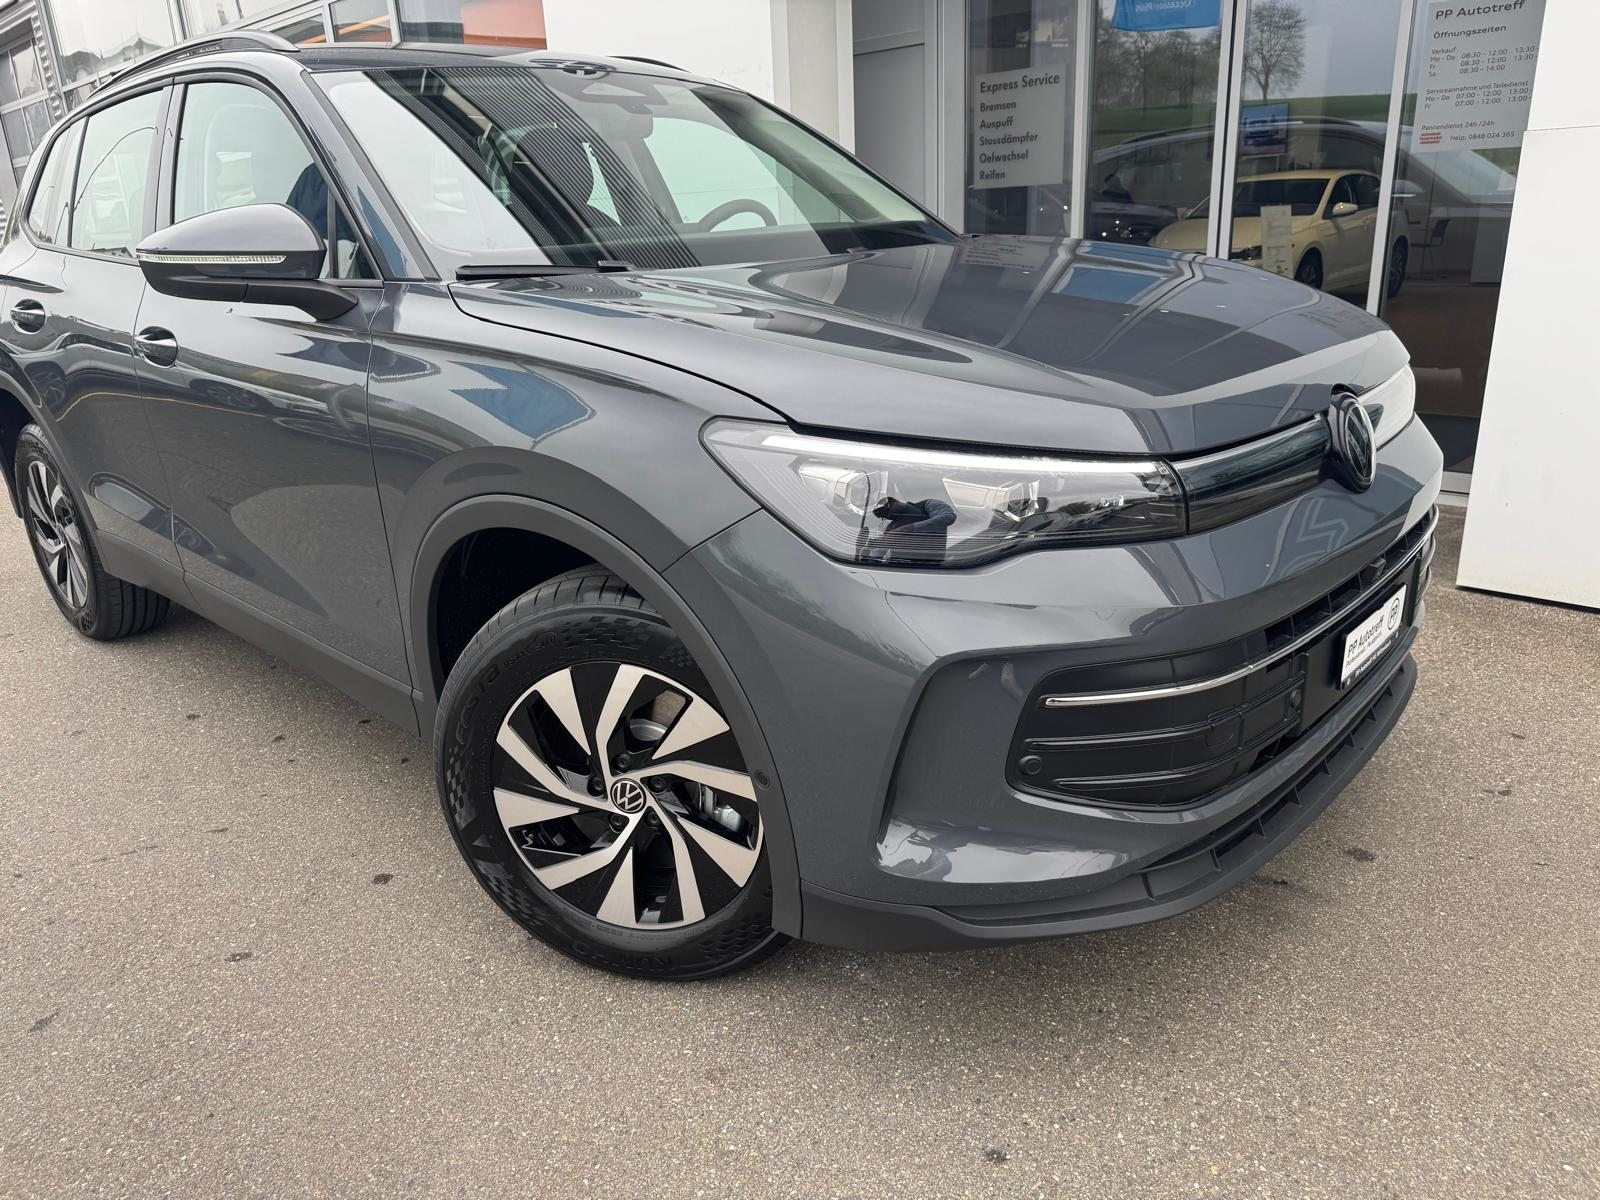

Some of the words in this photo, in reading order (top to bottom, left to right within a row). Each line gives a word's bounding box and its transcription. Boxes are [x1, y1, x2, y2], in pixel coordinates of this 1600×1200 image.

[1435, 9, 1453, 20] PP
[1456, 1, 1526, 18] Autotreff
[1433, 25, 1507, 39] Öffnungszeiten
[1431, 46, 1456, 55] Verkauf
[1461, 51, 1481, 59] 08:30
[1515, 45, 1535, 53] 13:30
[1460, 59, 1480, 67] 08:30
[1487, 56, 1507, 64] 12:00
[1514, 53, 1534, 61] 13:30
[1459, 66, 1479, 74] 08:30
[980, 80, 1018, 94] Express
[1022, 73, 1060, 88] Service
[1426, 85, 1477, 94] Serviceannahme
[1493, 80, 1529, 88] Teiledienst
[1455, 99, 1475, 107] 07:00
[1481, 97, 1501, 105] 12:00
[1456, 92, 1475, 100] 07:00
[980, 102, 1017, 112] Bremsen
[979, 116, 1014, 129] Auspuff
[1421, 122, 1463, 131] Pannendienst
[979, 131, 1038, 146] Stossdämpfer
[979, 149, 1029, 163] Oelwechsel
[979, 169, 1006, 181] Reifen
[1348, 639, 1358, 658] PP
[1358, 614, 1385, 646] Autotreff
